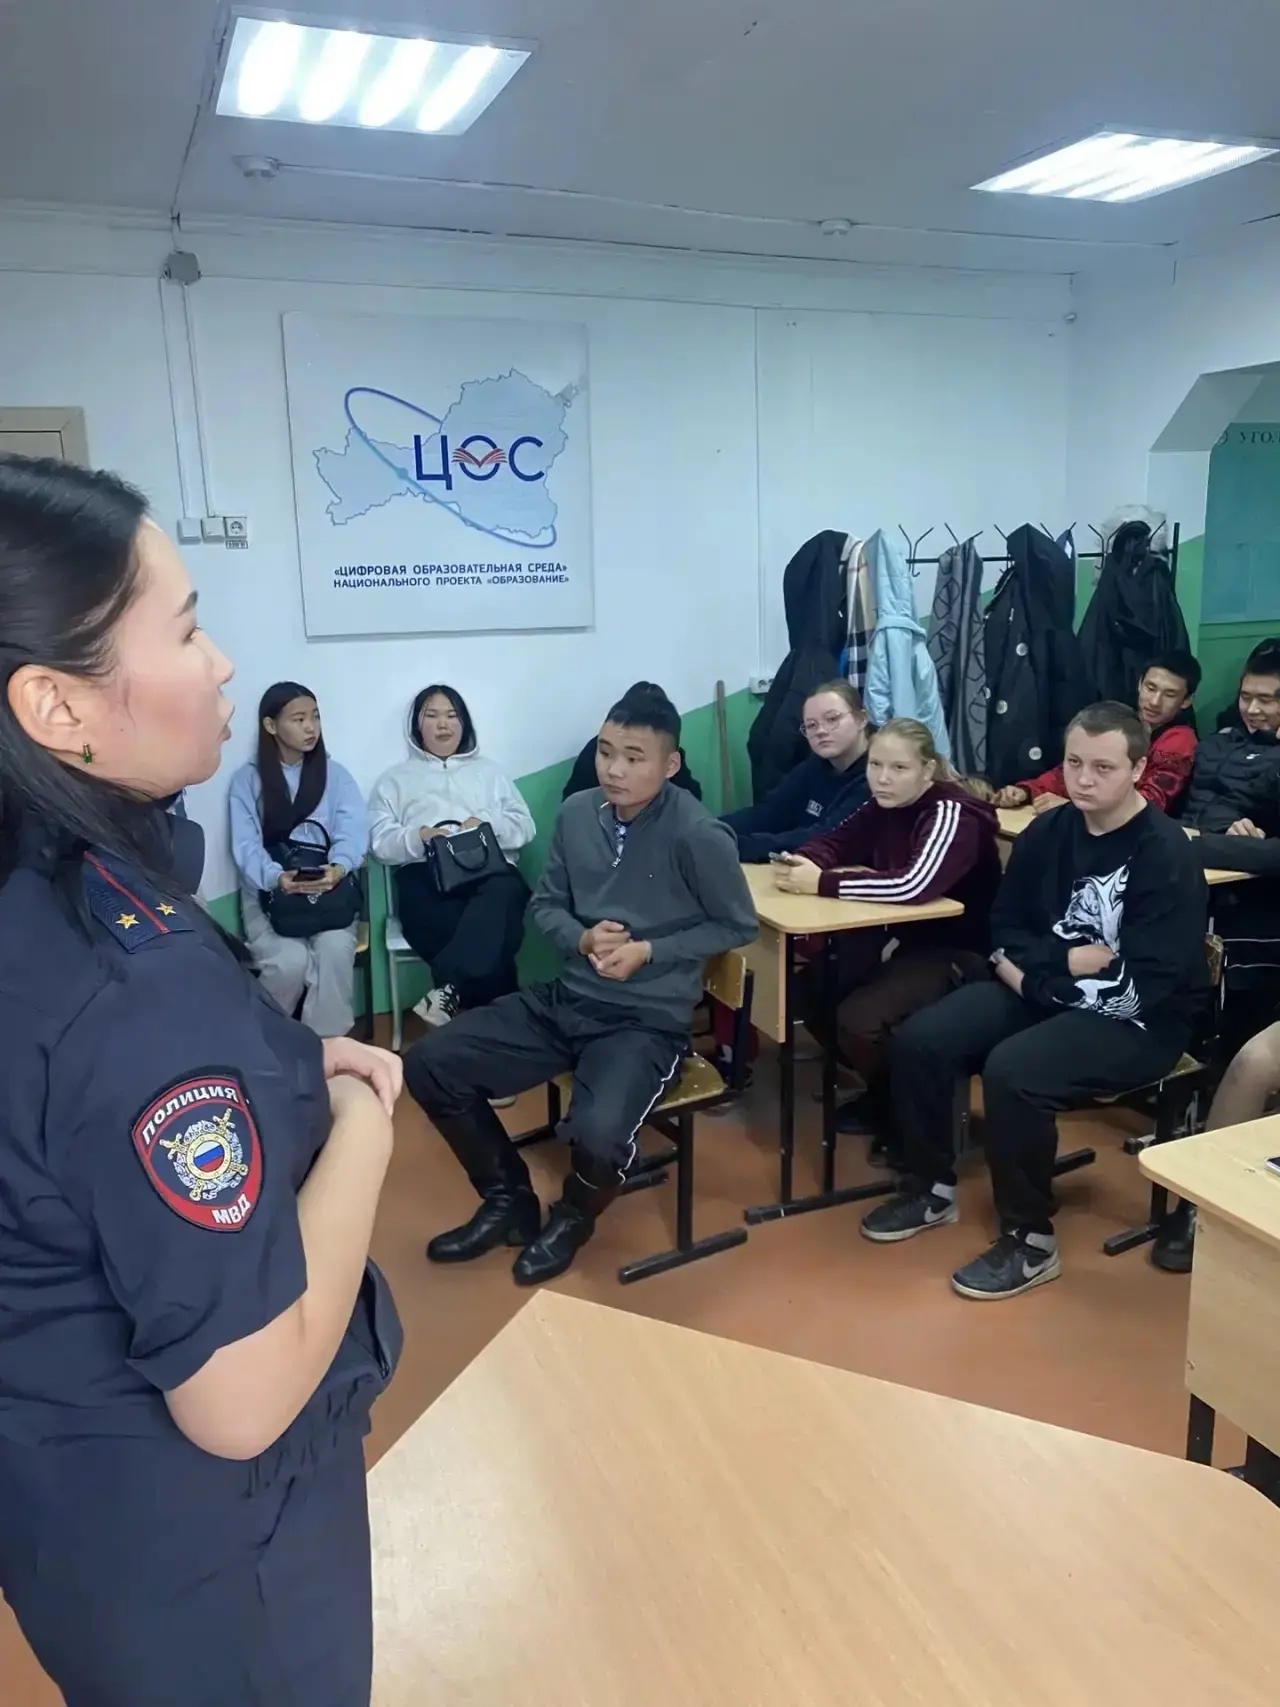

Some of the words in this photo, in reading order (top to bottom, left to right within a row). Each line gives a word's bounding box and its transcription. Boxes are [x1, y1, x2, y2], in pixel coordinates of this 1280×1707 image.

[413, 434, 545, 491] ЦОС
[333, 577, 431, 589] НАЦИОНАЛЬНОГО
[435, 576, 482, 587] ПРОЕКТА
[487, 574, 570, 585] «ОБРАЗОВАНИЕ»
[334, 565, 407, 577] «ЦИФРОВАЯ
[413, 563, 522, 575] ОБРАЗОВАТЕЛЬНАЯ
[528, 562, 568, 574] СРЕДА»
[142, 1086, 240, 1145] ПОЛИЦИЯ
[211, 1193, 251, 1224] МВД
